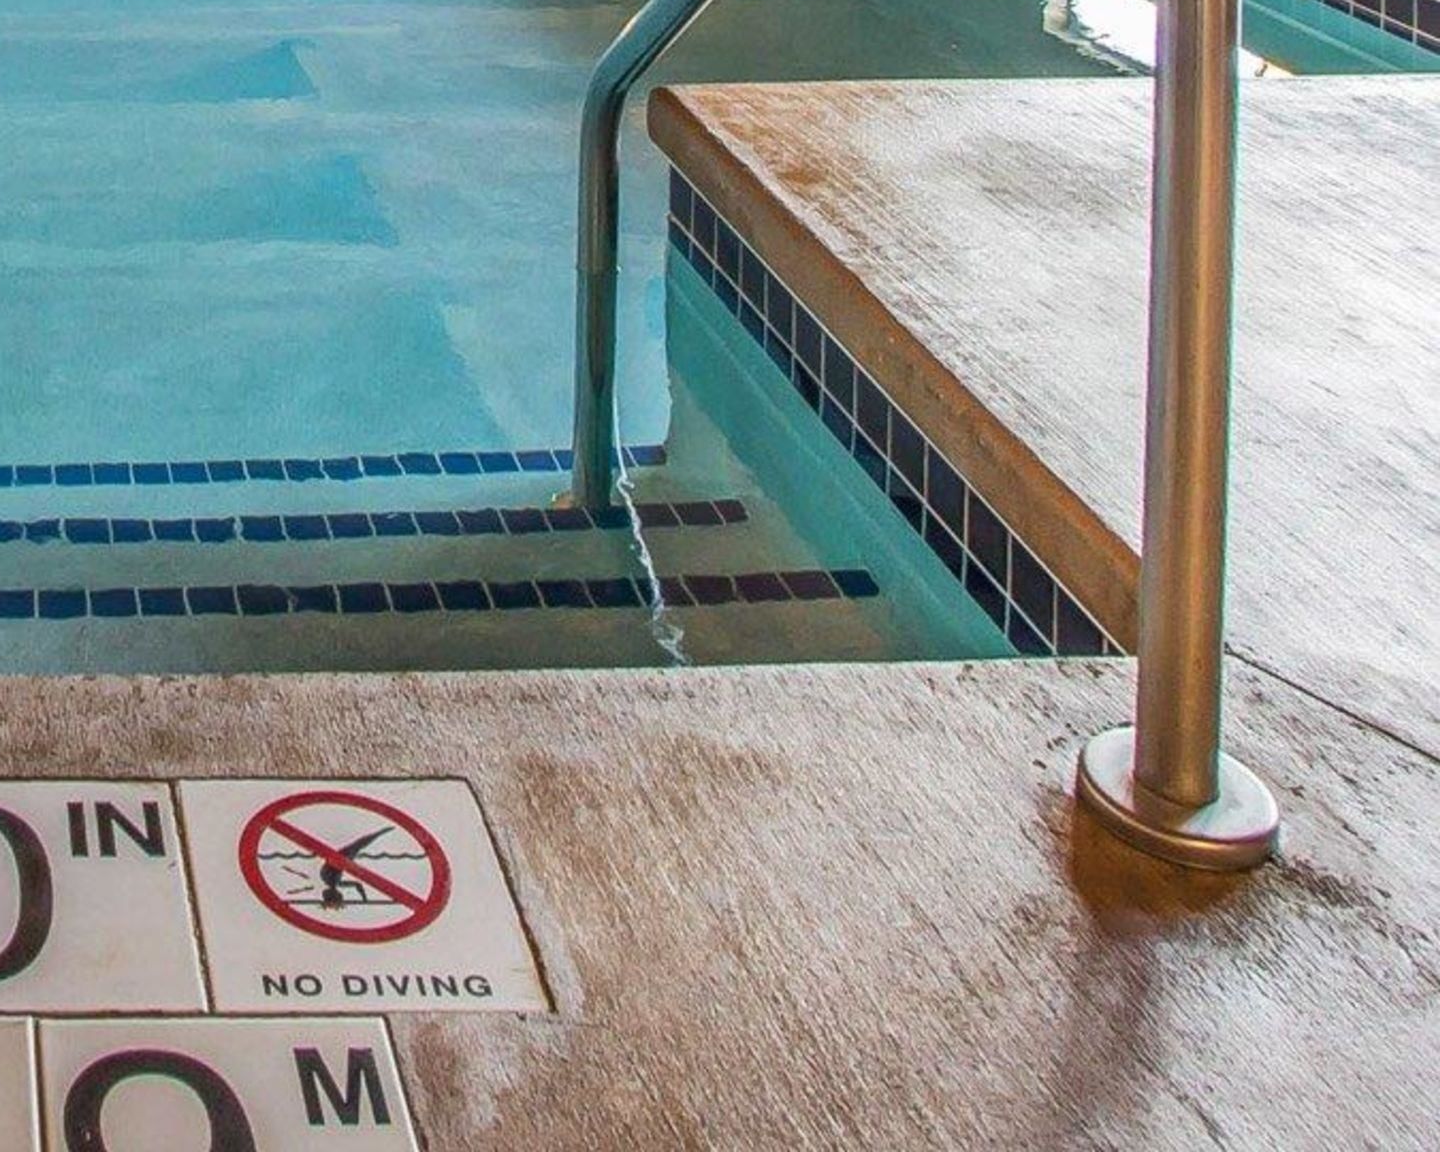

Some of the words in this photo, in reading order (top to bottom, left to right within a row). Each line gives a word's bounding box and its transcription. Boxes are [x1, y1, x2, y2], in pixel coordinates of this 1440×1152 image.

[67, 801, 168, 858] IN
[261, 974, 323, 997] NO
[341, 974, 493, 997] DIVING
[292, 1047, 391, 1125] M
